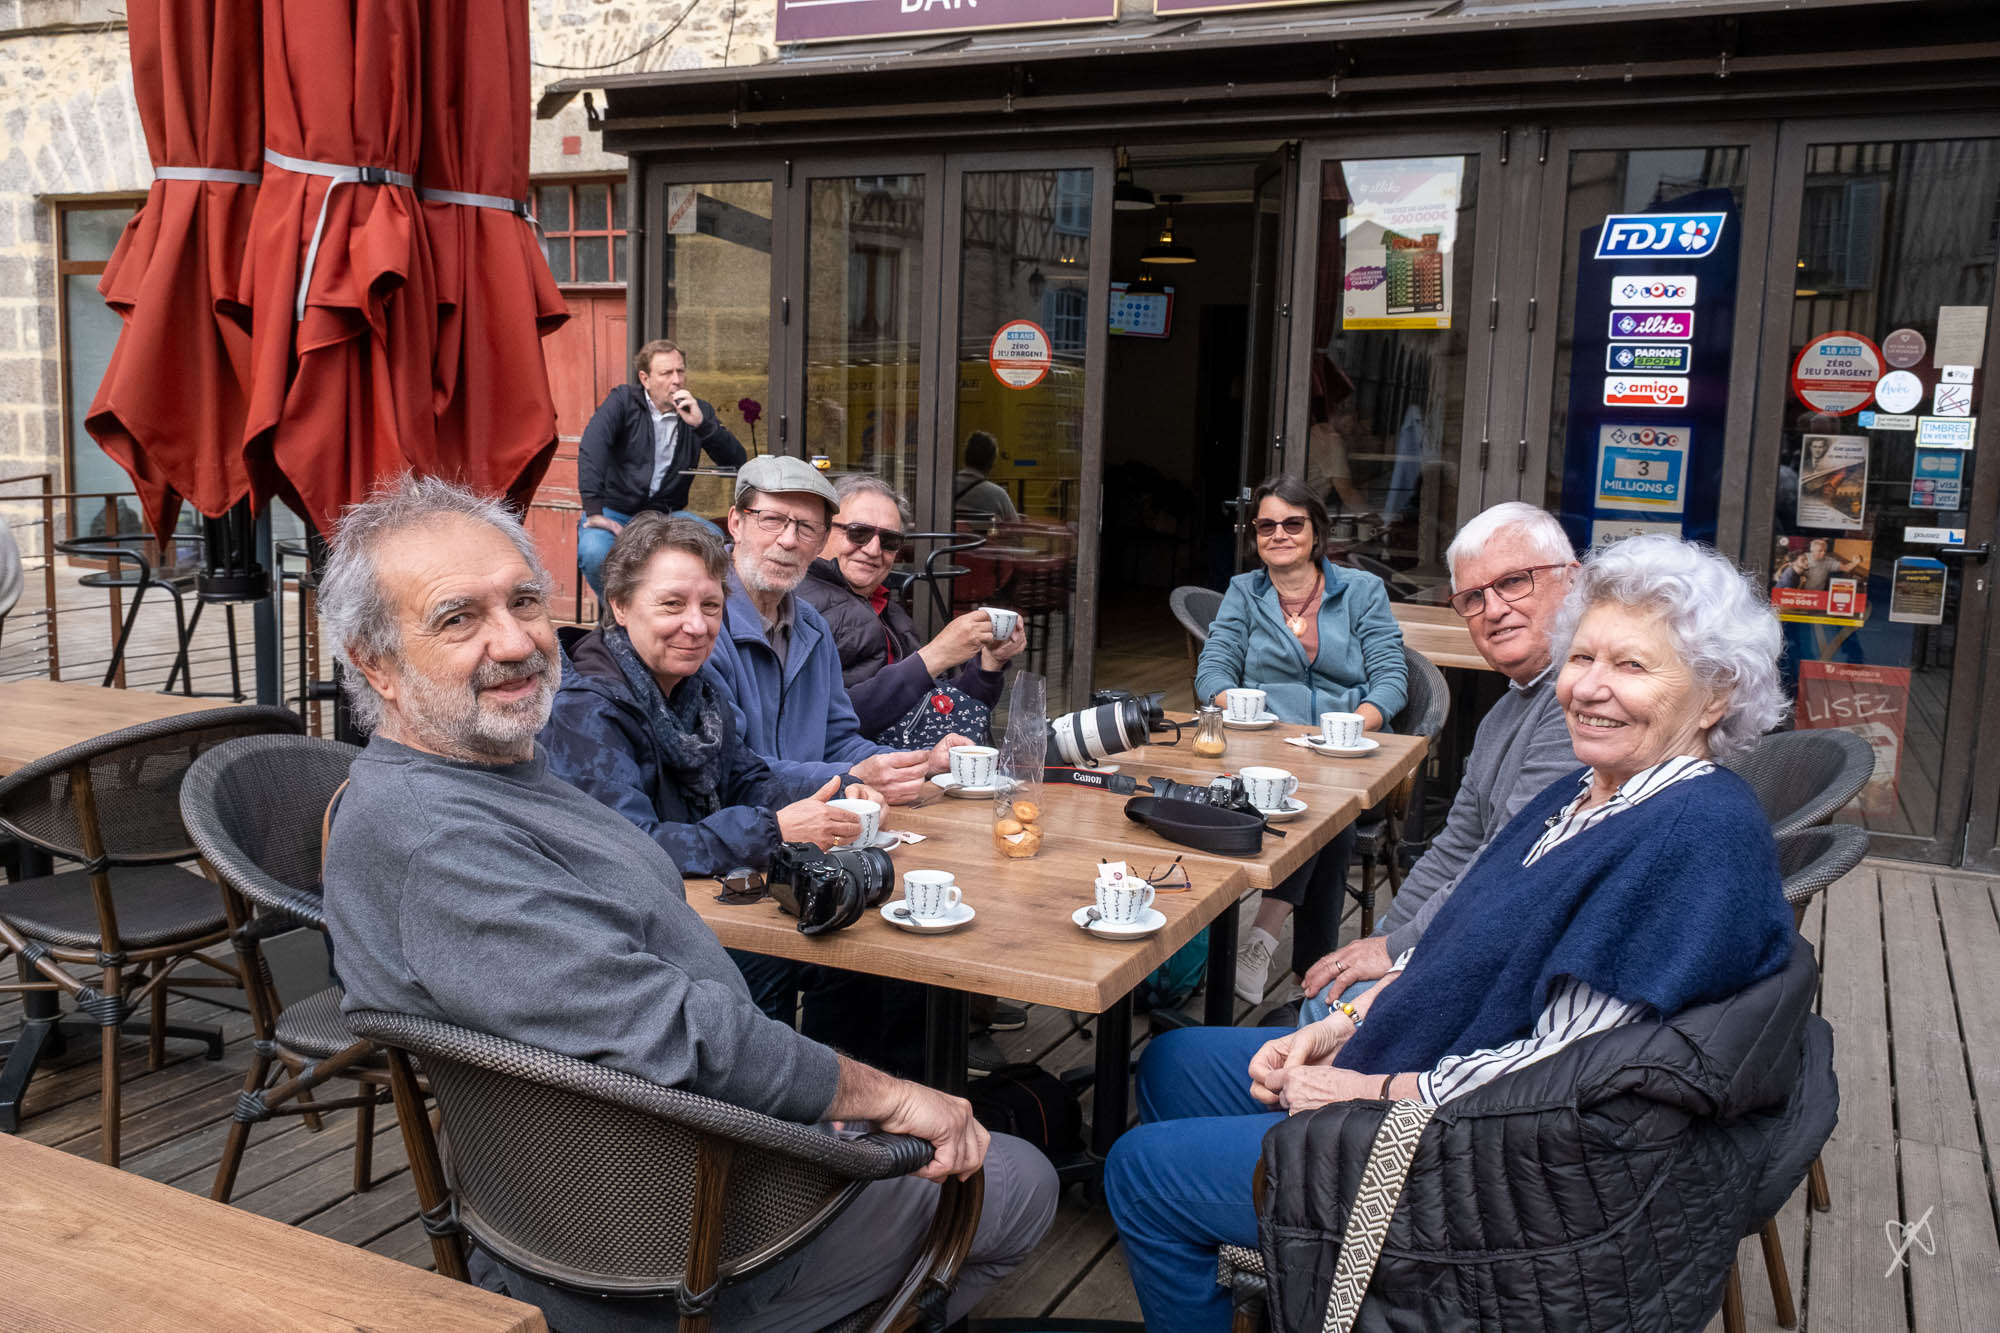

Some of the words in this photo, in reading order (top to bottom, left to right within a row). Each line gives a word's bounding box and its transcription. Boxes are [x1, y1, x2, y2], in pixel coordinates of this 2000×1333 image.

[1606, 222, 1676, 250] FDJ
[1640, 282, 1687, 298] LOTO
[1634, 315, 1684, 334] illiko
[1011, 342, 1029, 350] ZÉRO
[1635, 348, 1682, 358] PARIONS
[1839, 347, 1860, 355] ANS
[1011, 350, 1042, 358] D'ARGENT
[1826, 359, 1852, 368] ZÉRO
[1804, 368, 1822, 376] JEU
[1824, 368, 1872, 377] D'ARGENT
[1629, 381, 1678, 401] amigo
[1924, 423, 1967, 433] TIMBRES
[1629, 428, 1679, 446] LOTO
[1637, 461, 1649, 476] 3
[1922, 456, 1957, 471] CB
[1604, 480, 1662, 493] MILLIONS
[1664, 484, 1675, 494] €
[1805, 693, 1899, 722] LISEZ
[1073, 772, 1102, 784] Canon
